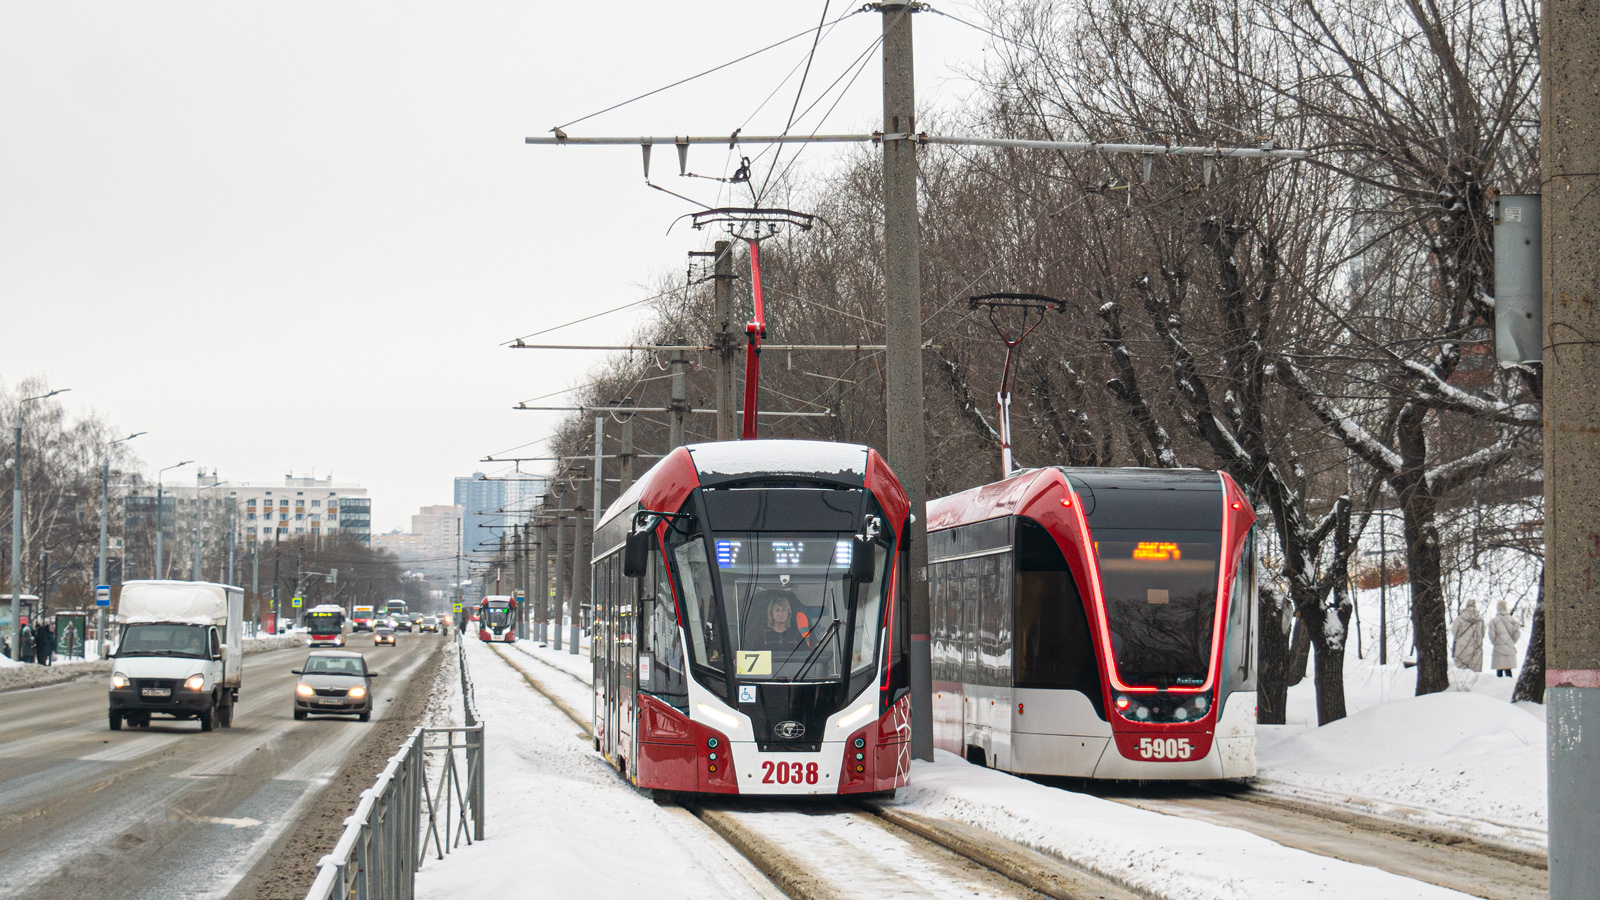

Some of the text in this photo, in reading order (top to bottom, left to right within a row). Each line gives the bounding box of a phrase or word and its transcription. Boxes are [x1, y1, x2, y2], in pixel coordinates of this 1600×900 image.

[743, 654, 760, 673] 7
[1139, 738, 1191, 759] 5905
[761, 761, 819, 785] 2038
